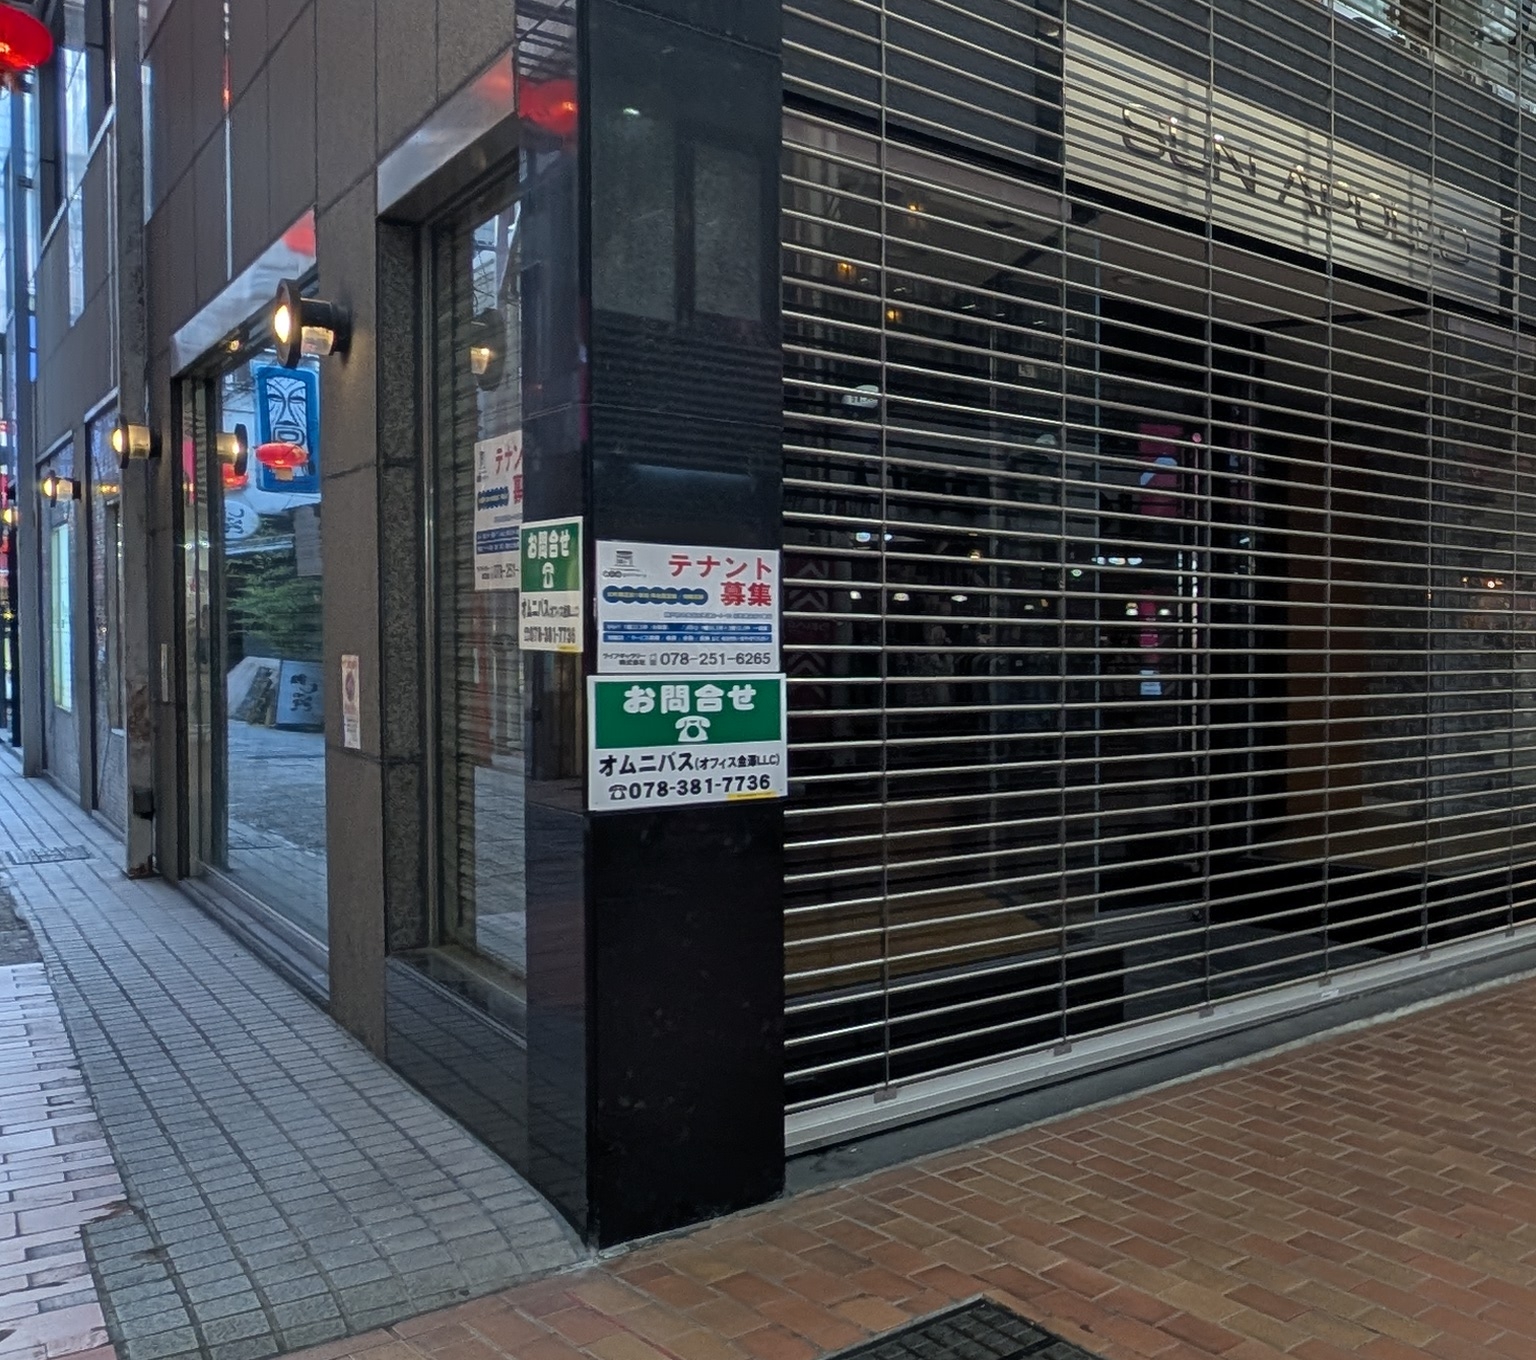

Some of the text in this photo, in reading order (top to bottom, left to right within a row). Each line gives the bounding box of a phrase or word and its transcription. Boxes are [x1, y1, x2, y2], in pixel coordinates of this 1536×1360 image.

[495, 447, 523, 475] テナン
[527, 529, 571, 560] お問合せ
[668, 554, 772, 580] テナント
[720, 581, 772, 607] 募集
[660, 652, 771, 666] 078-251-6265
[622, 683, 757, 715] お問合せ
[628, 774, 771, 800] 078-381-7736
